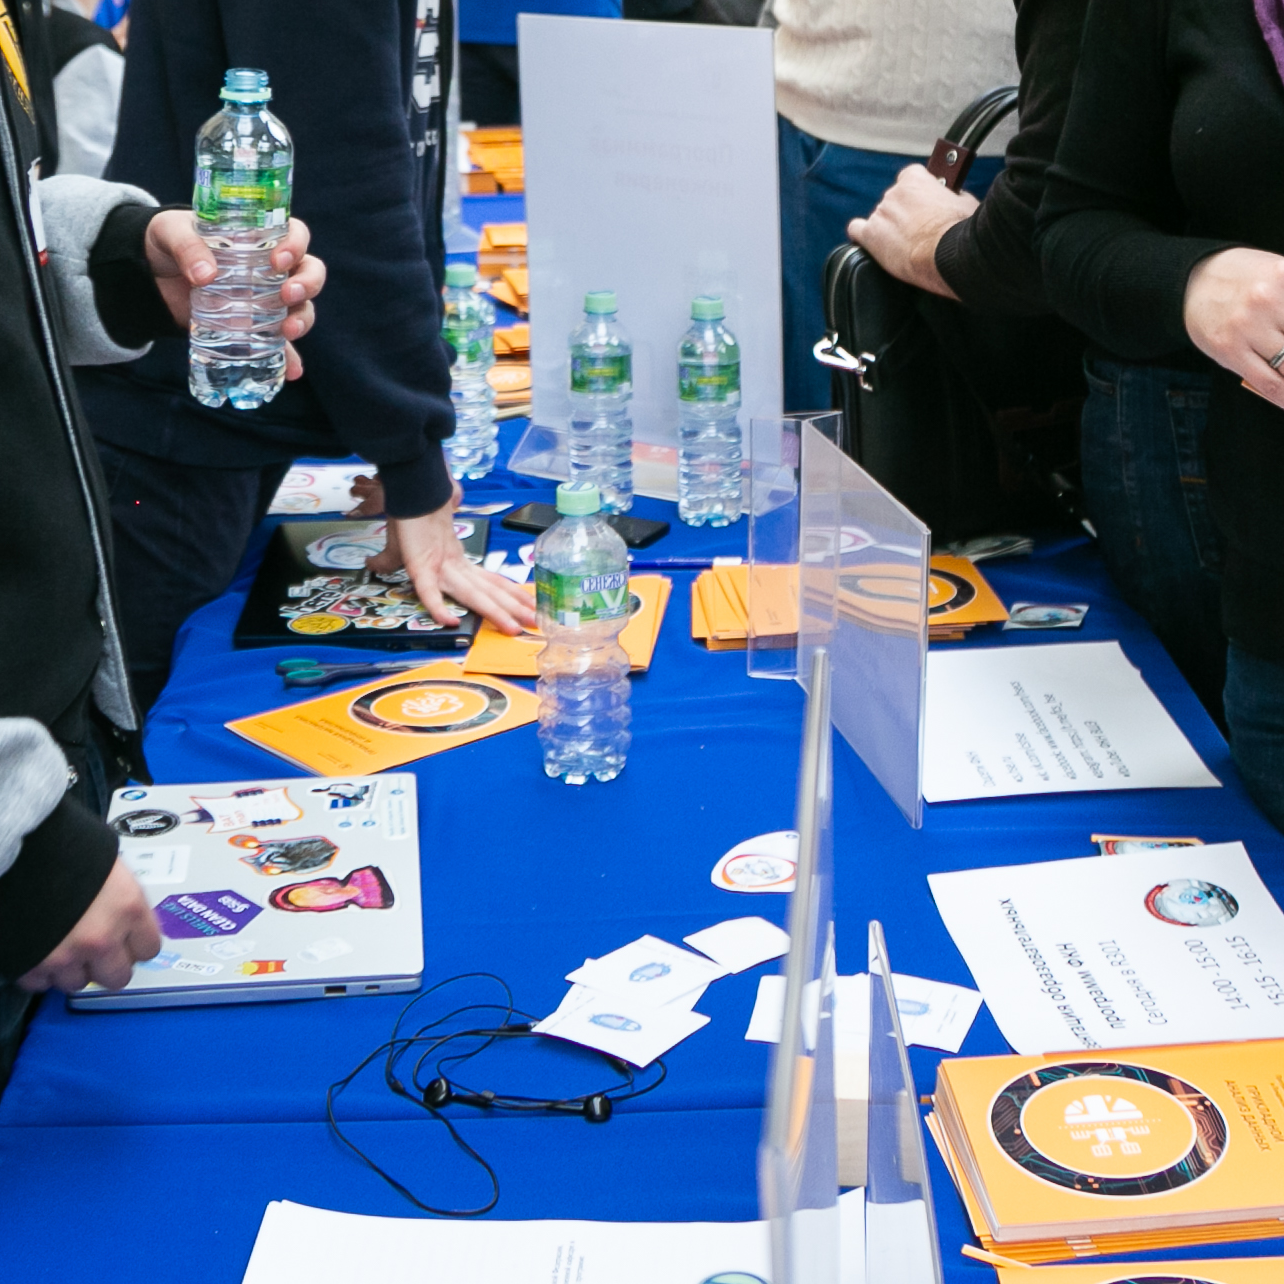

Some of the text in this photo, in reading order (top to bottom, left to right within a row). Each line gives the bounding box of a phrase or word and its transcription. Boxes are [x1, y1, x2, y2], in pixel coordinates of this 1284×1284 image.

[177, 895, 236, 931] CLEAN DATA
[179, 912, 219, 936] SMELLS
[998, 898, 1066, 1001] образовательных
[1184, 939, 1221, 969] 15:00
[1225, 935, 1263, 966] 16:15
[1055, 942, 1126, 1029] программ ФКН
[1098, 939, 1168, 1026] Сегодня в R301
[1212, 978, 1251, 1010] 14:00
[1224, 1079, 1272, 1151] АНАЛИЗ ДАННЫХ
